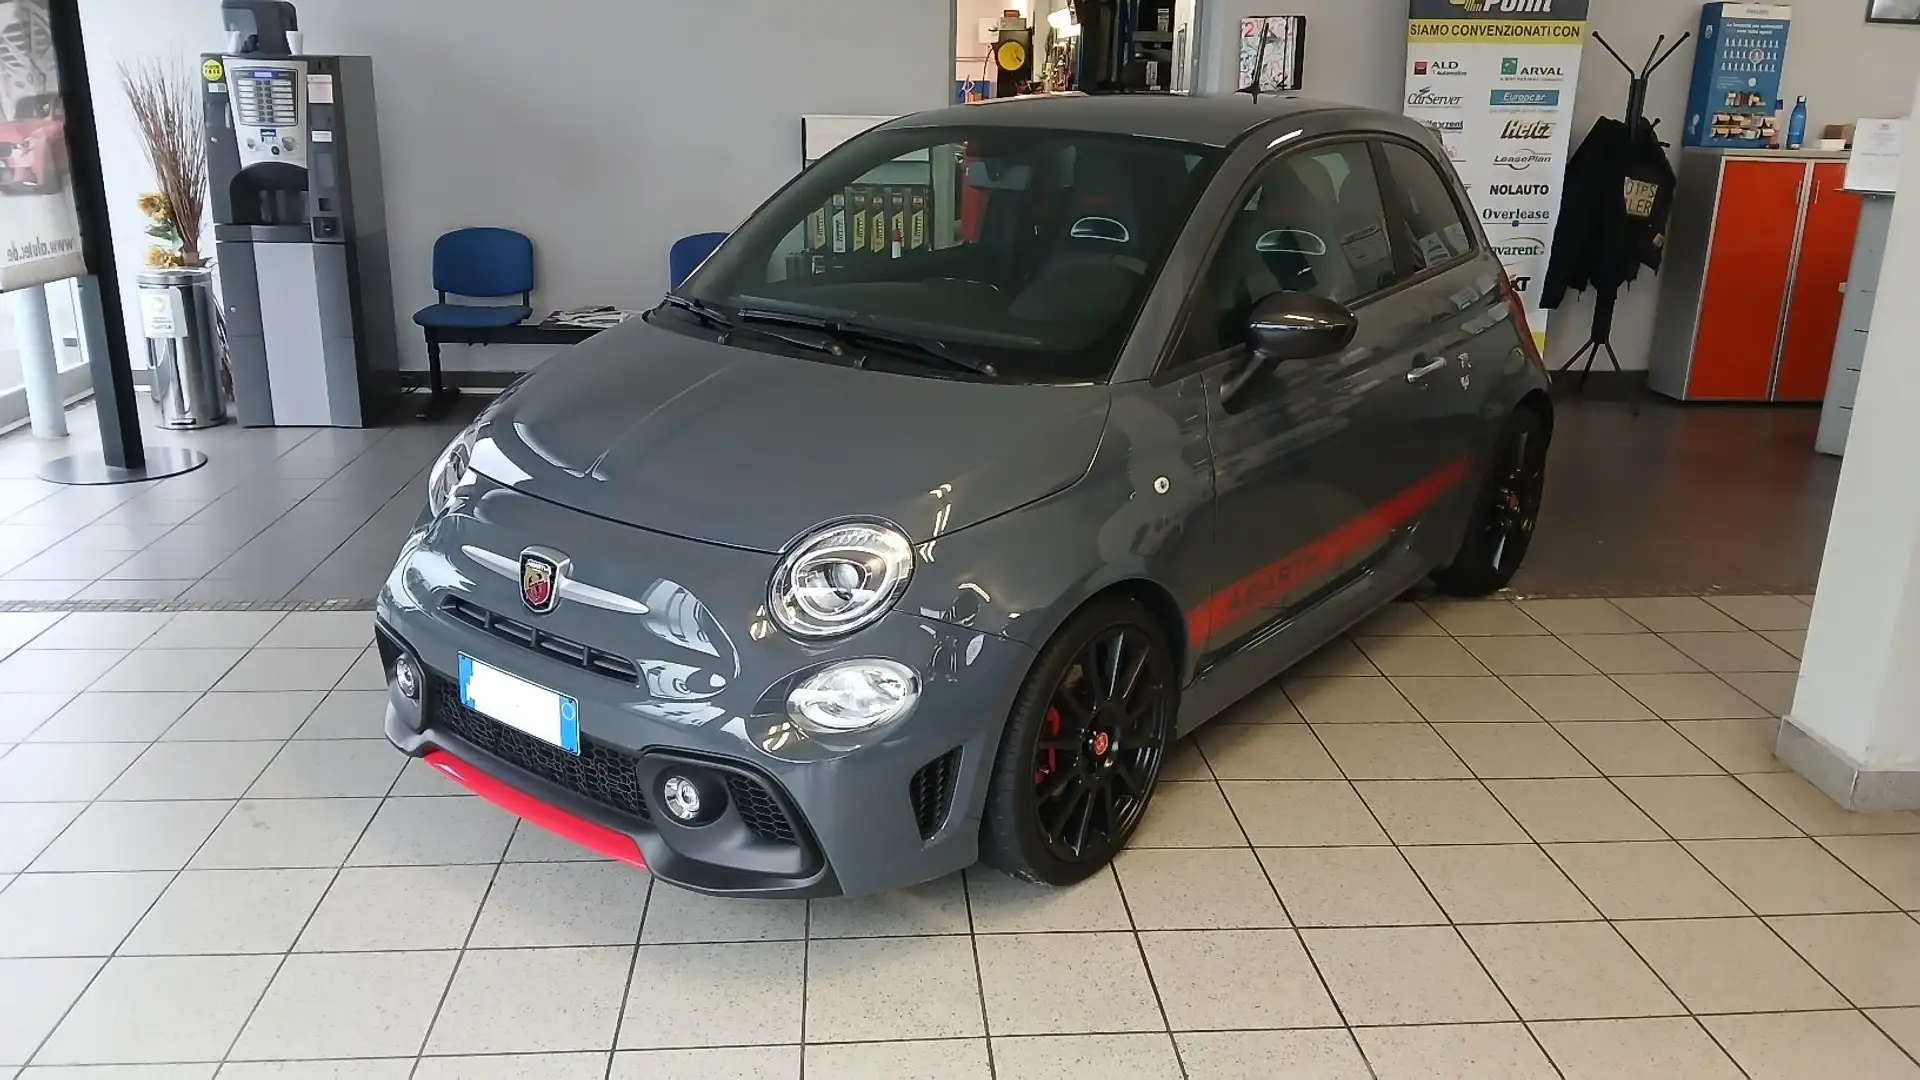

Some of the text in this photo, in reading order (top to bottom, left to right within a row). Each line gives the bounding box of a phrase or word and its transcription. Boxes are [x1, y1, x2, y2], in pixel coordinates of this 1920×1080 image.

[1410, 24, 1581, 37] SIAMO CONVENZIONATI CON
[1431, 61, 1459, 69] ALD
[1520, 67, 1564, 76] ARVAL
[1503, 92, 1546, 103] Europcar
[1501, 119, 1555, 139] Hertz
[1494, 155, 1551, 163] LeasePlan
[1489, 184, 1549, 195] NOLAUTO
[1482, 208, 1550, 219] Overlease
